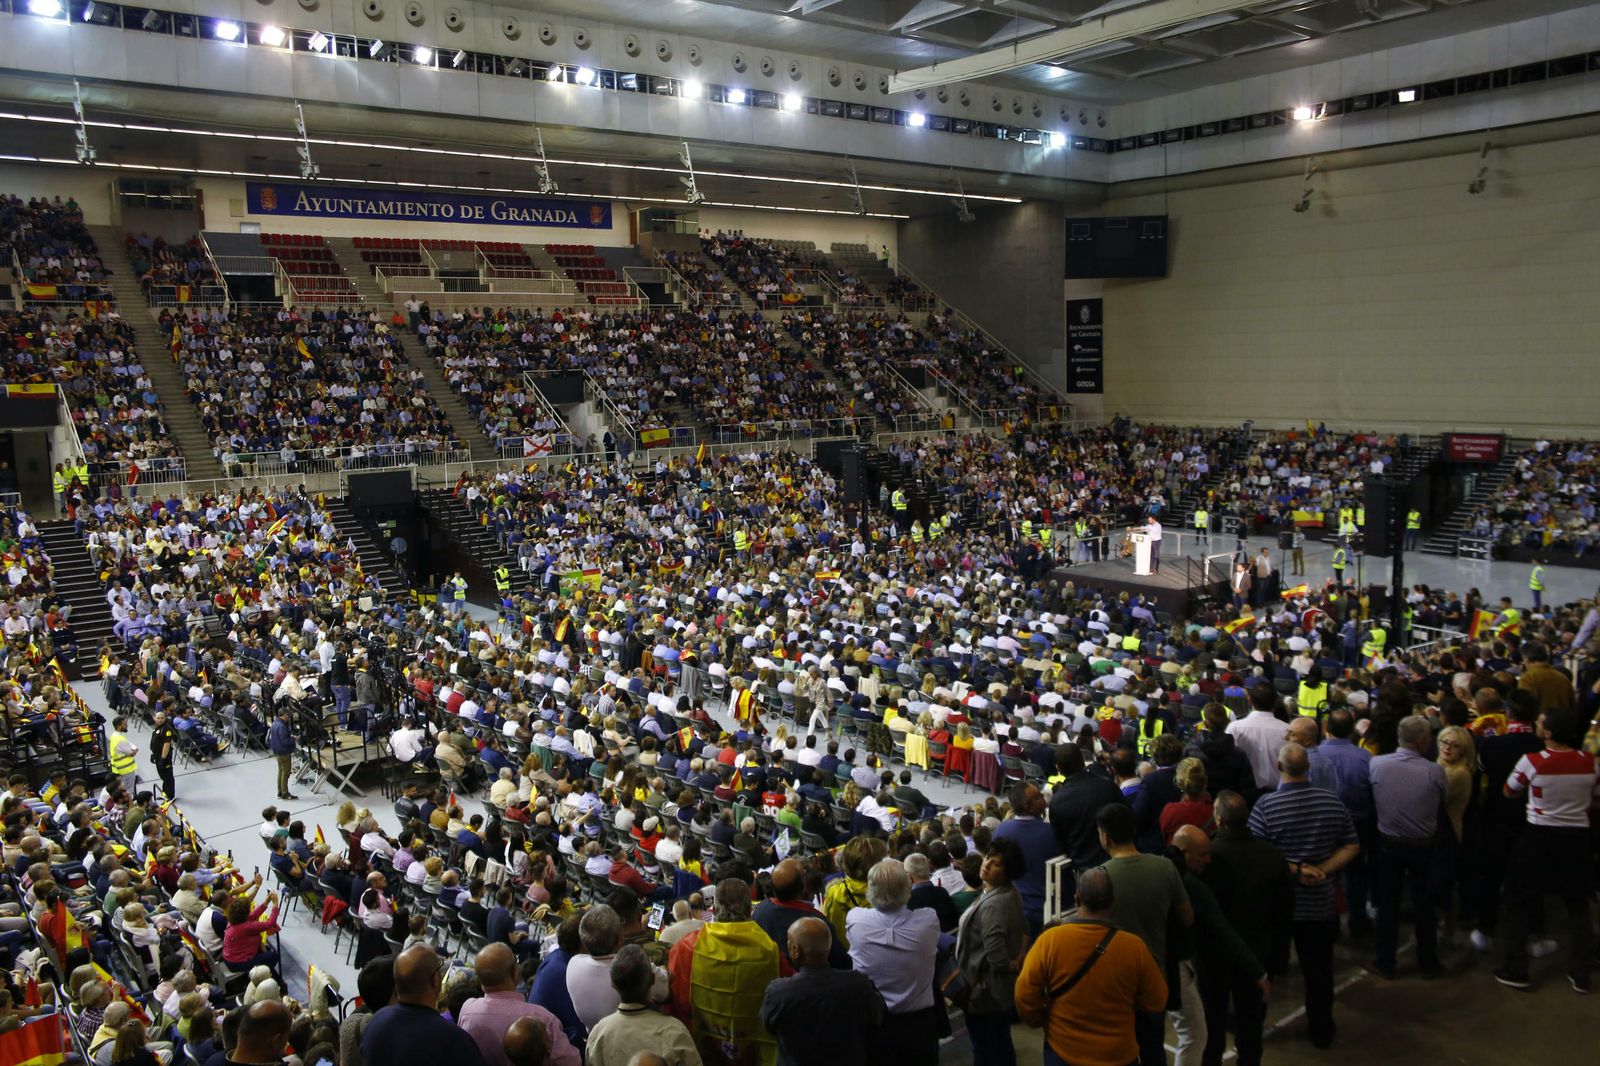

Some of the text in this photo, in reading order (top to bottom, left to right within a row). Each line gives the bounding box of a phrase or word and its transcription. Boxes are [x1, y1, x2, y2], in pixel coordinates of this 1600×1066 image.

[294, 190, 579, 224] AYUNTAMIENTO DE GRANADA
